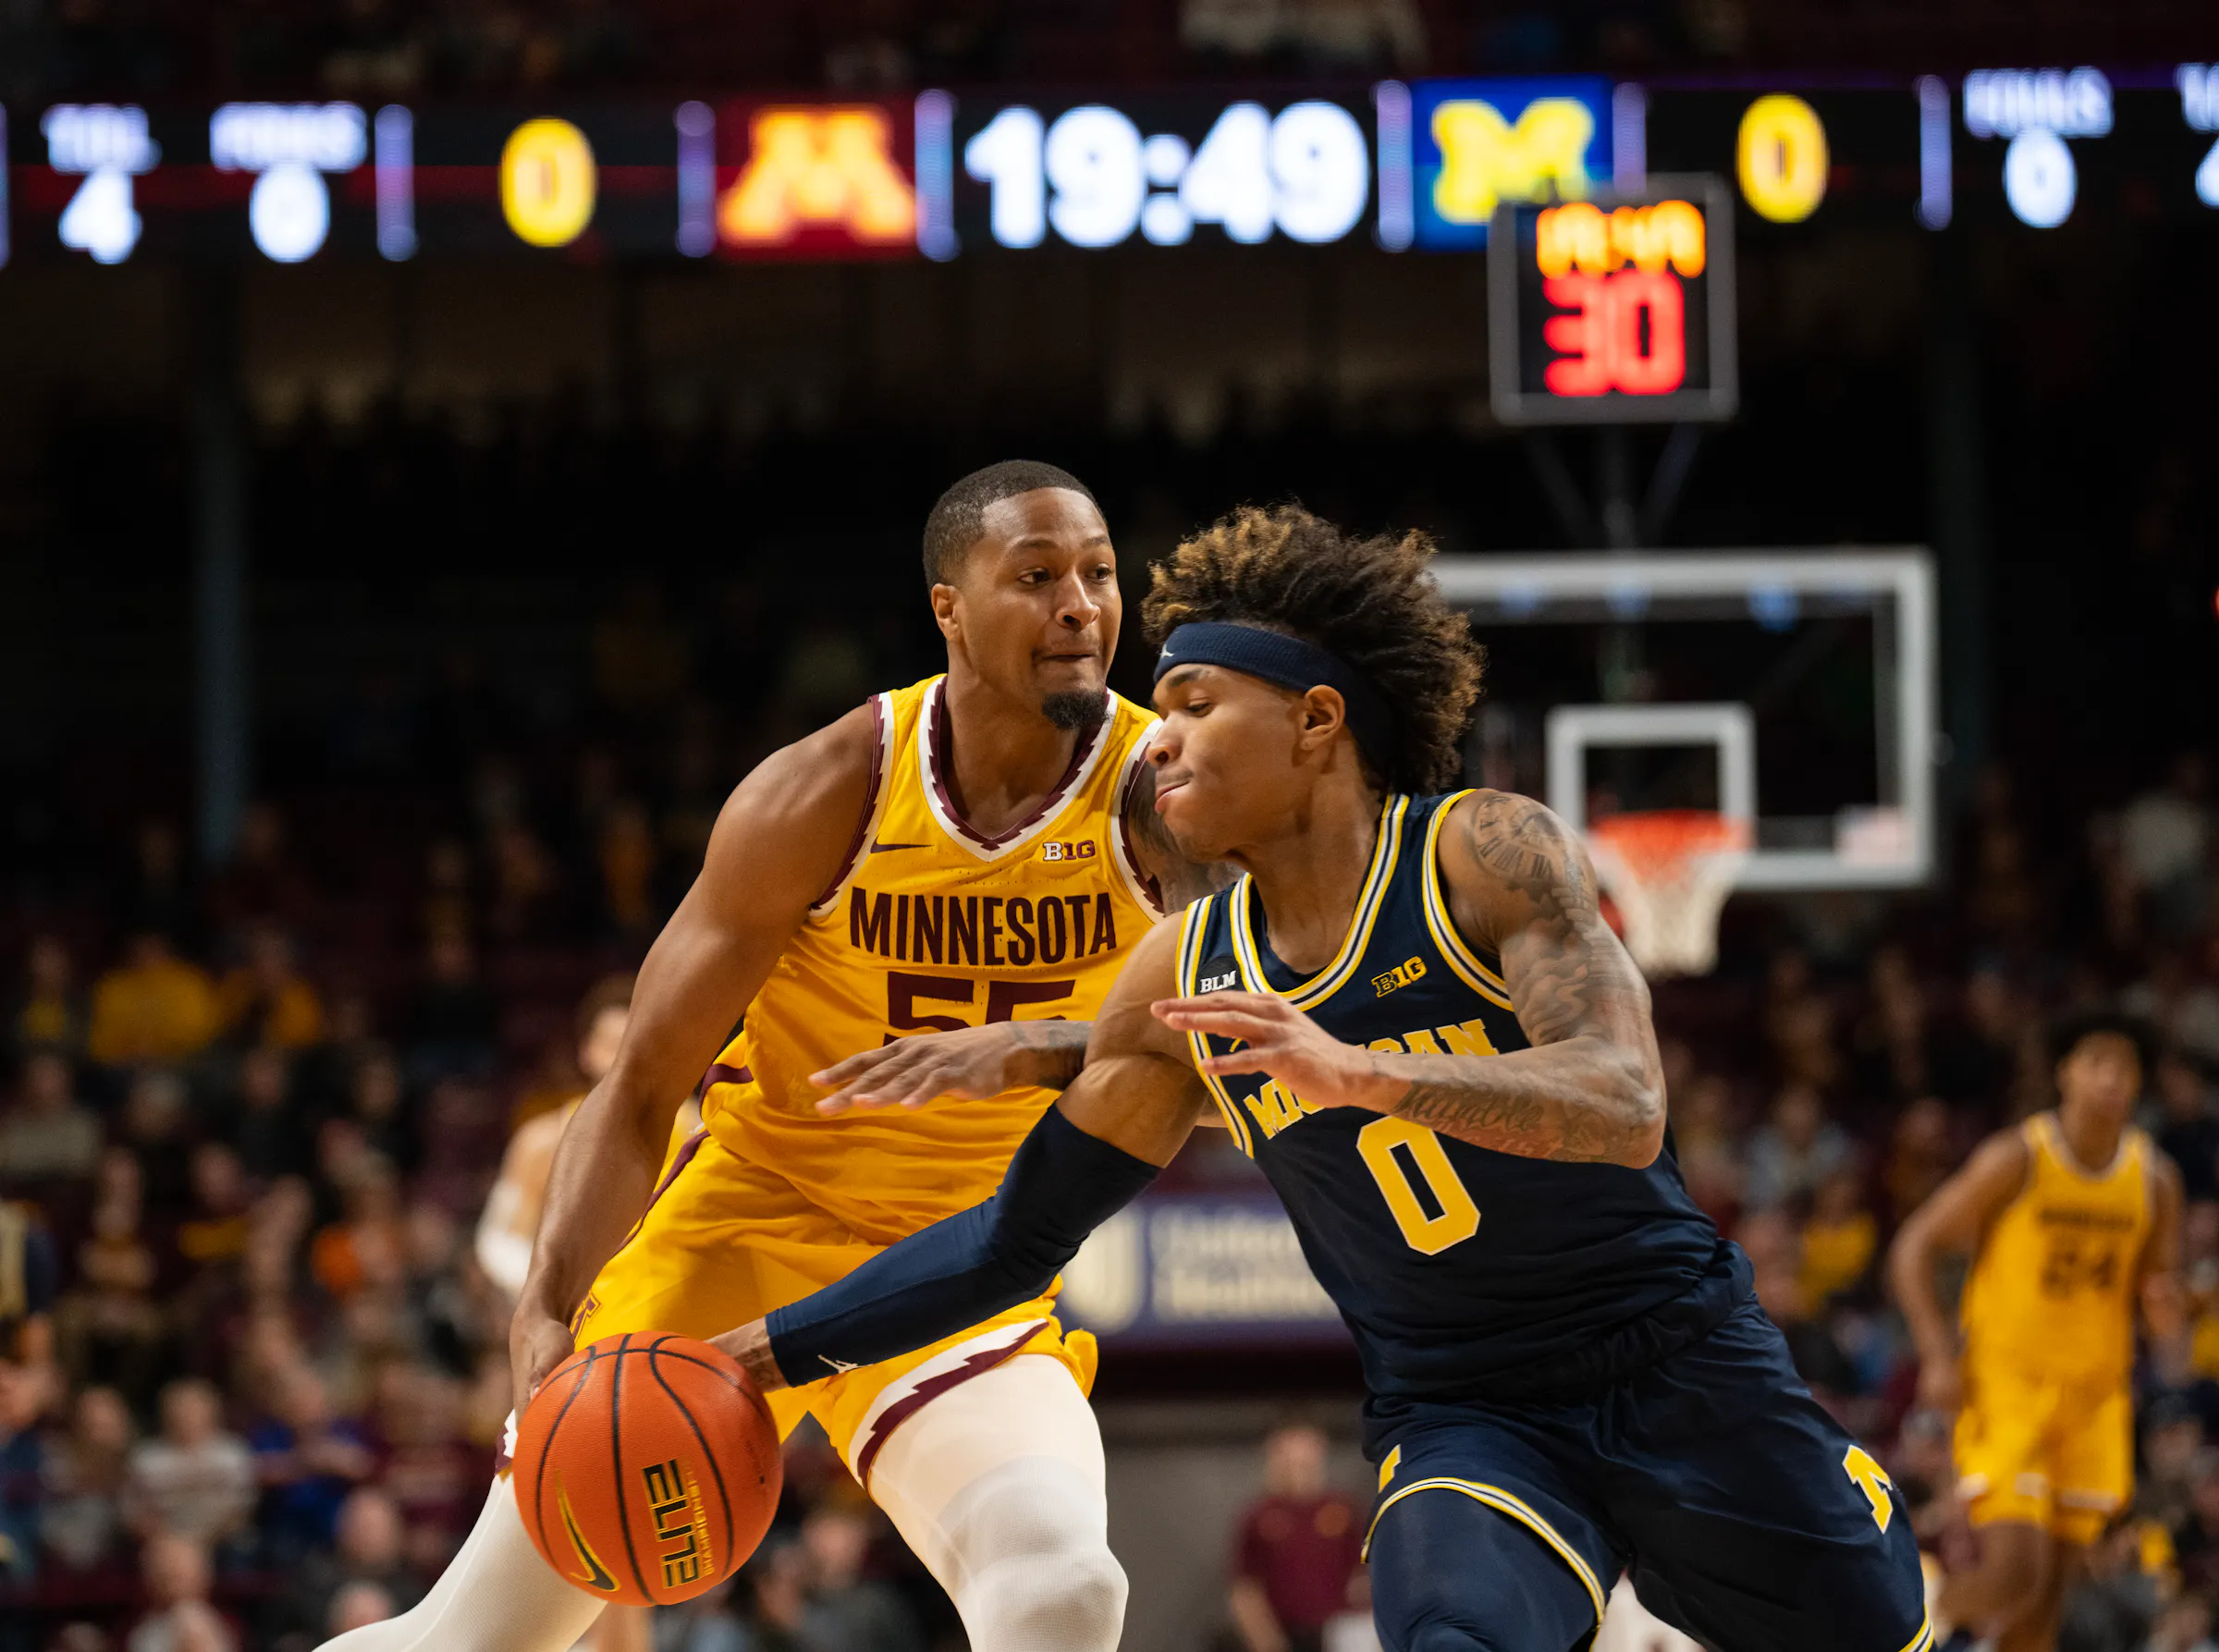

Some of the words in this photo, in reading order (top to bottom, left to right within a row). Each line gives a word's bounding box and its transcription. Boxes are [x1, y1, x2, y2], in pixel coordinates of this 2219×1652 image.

[58, 167, 142, 264] 4
[249, 165, 331, 263] 0
[499, 116, 596, 248] 0
[716, 104, 917, 244] M
[964, 100, 1369, 248] 19:49
[1431, 96, 1594, 225] M
[1736, 93, 1829, 223] 0
[2004, 130, 2077, 228] 0
[1543, 270, 1686, 398] 30
[849, 886, 1118, 967] MINNESOTA
[1200, 970, 1236, 994] BLM
[1355, 1114, 1481, 1256] 0
[642, 1457, 705, 1589] ELITE
